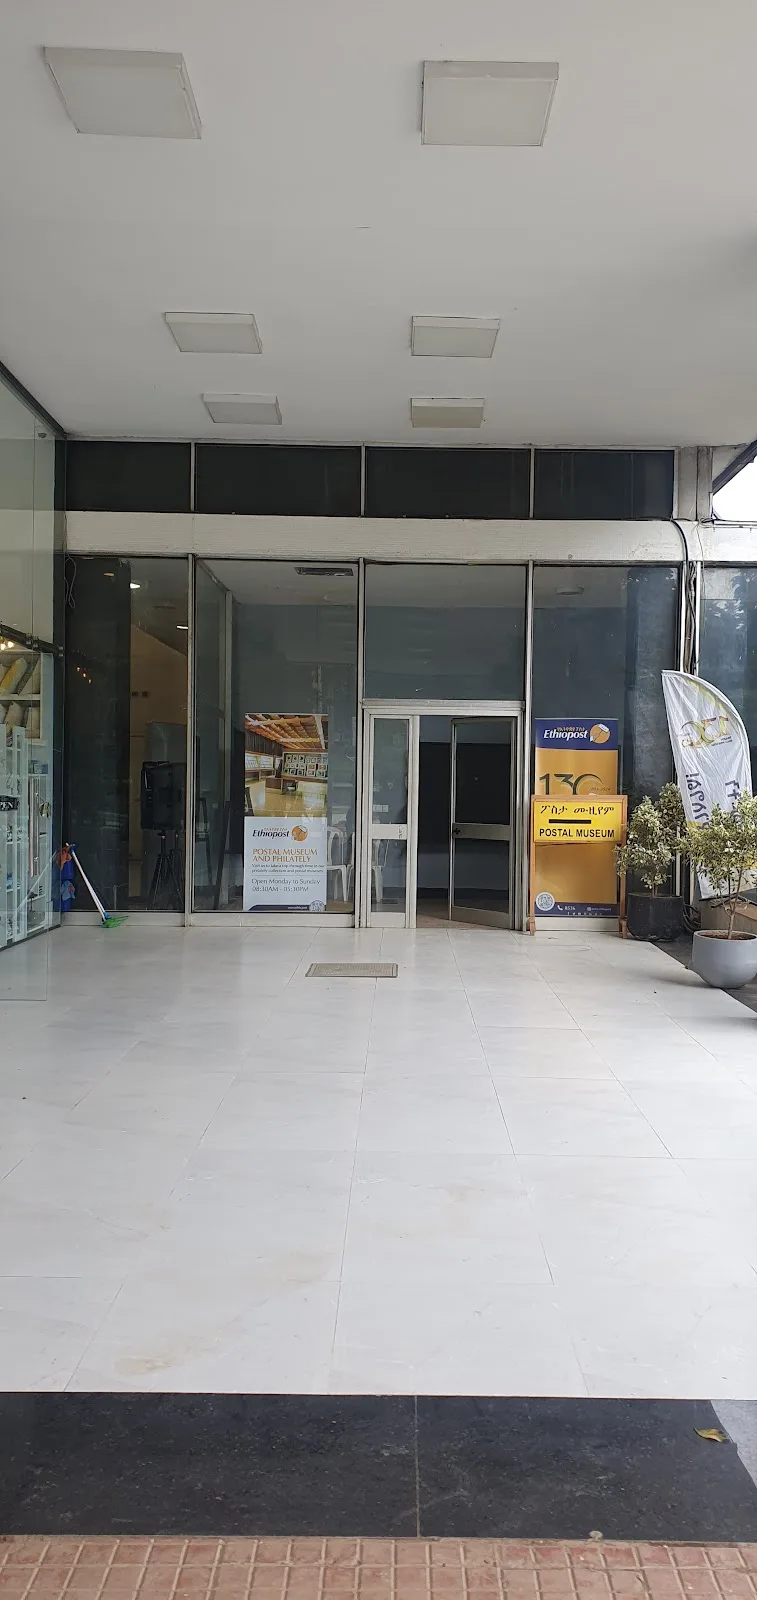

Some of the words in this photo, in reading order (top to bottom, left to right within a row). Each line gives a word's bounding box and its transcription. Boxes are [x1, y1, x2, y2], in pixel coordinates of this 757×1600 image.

[543, 729, 588, 741] Ethiopost
[252, 828, 290, 839] Ethiopost
[539, 828, 573, 837] POSTAL
[575, 829, 615, 838] MUSEUM
